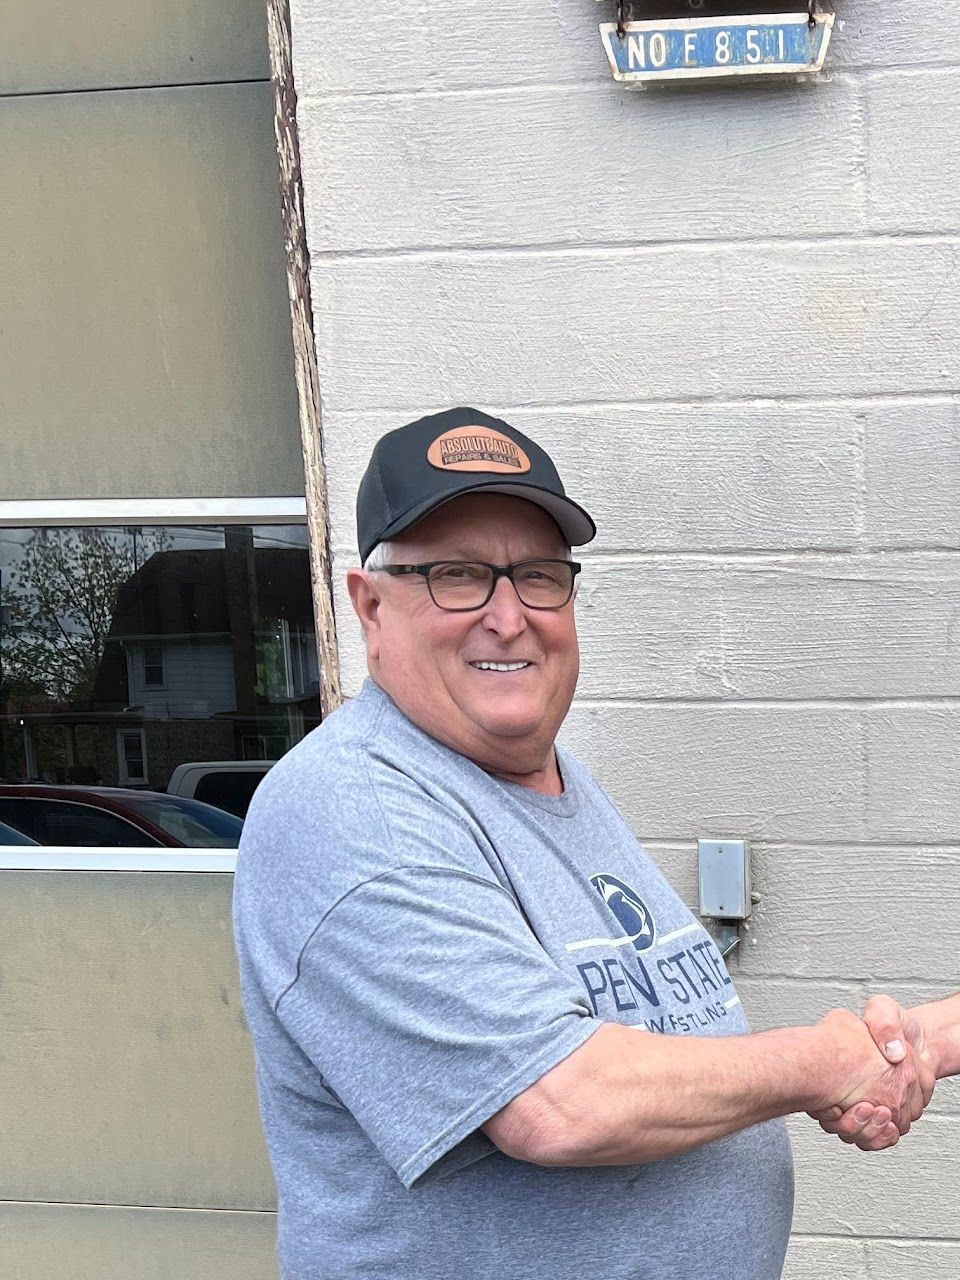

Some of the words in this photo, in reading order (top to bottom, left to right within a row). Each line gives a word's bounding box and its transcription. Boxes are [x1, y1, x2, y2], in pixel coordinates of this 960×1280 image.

[628, 32, 667, 68] NO
[440, 436, 493, 456] ABSOLUTE
[657, 940, 732, 1004] STATE
